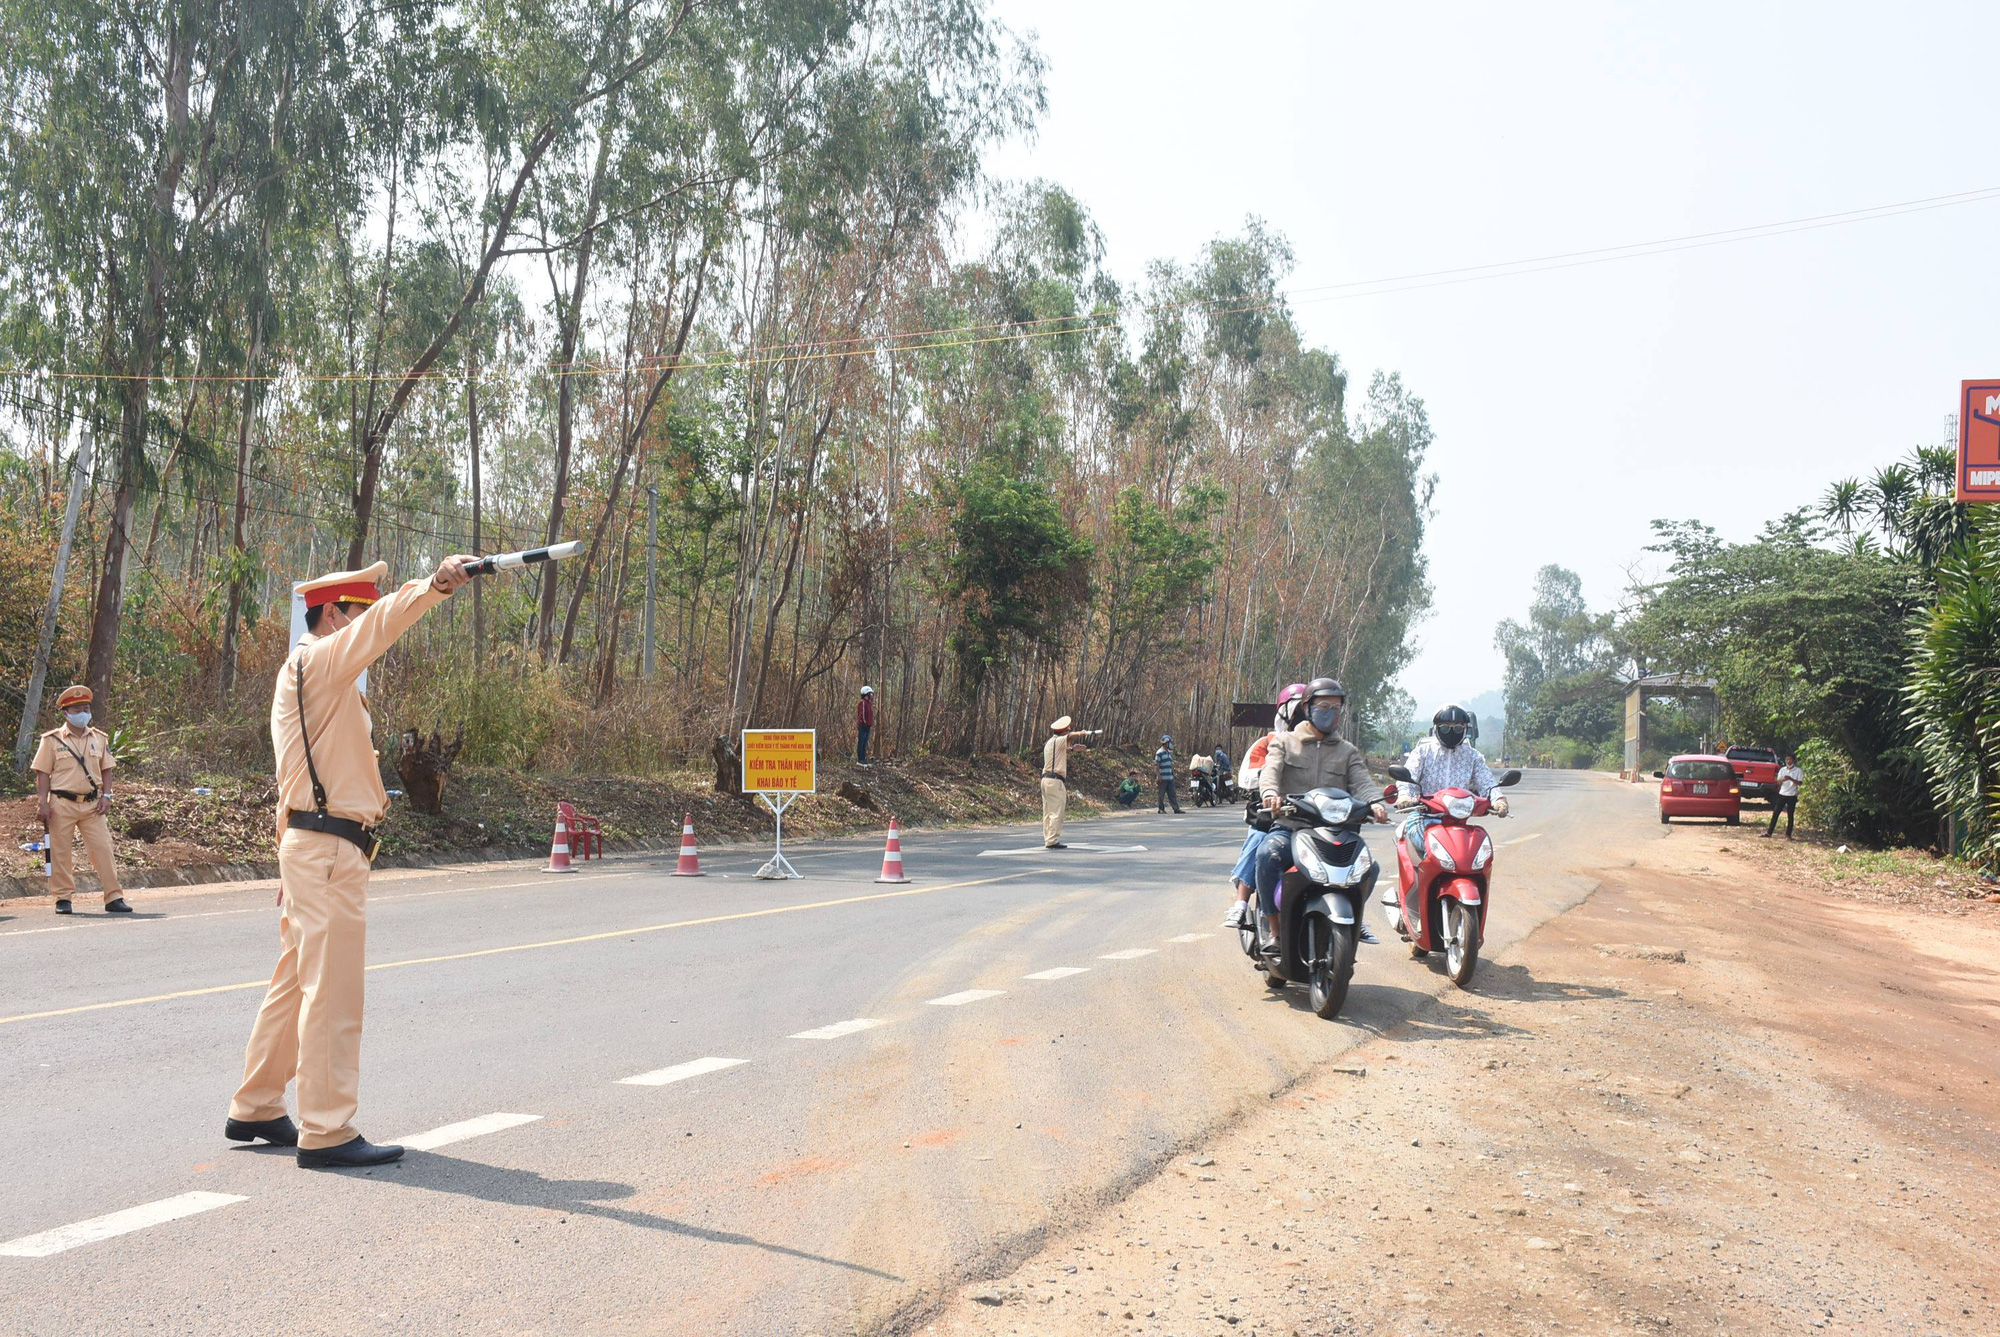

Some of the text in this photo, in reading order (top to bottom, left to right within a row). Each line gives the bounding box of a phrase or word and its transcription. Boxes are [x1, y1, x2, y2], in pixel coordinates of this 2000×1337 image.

[765, 760, 776, 770] TRA
[794, 758, 811, 772] NHIỆT
[756, 777, 770, 788] KHAI
[784, 777, 789, 788] Y
[790, 775, 797, 788] TẾ
